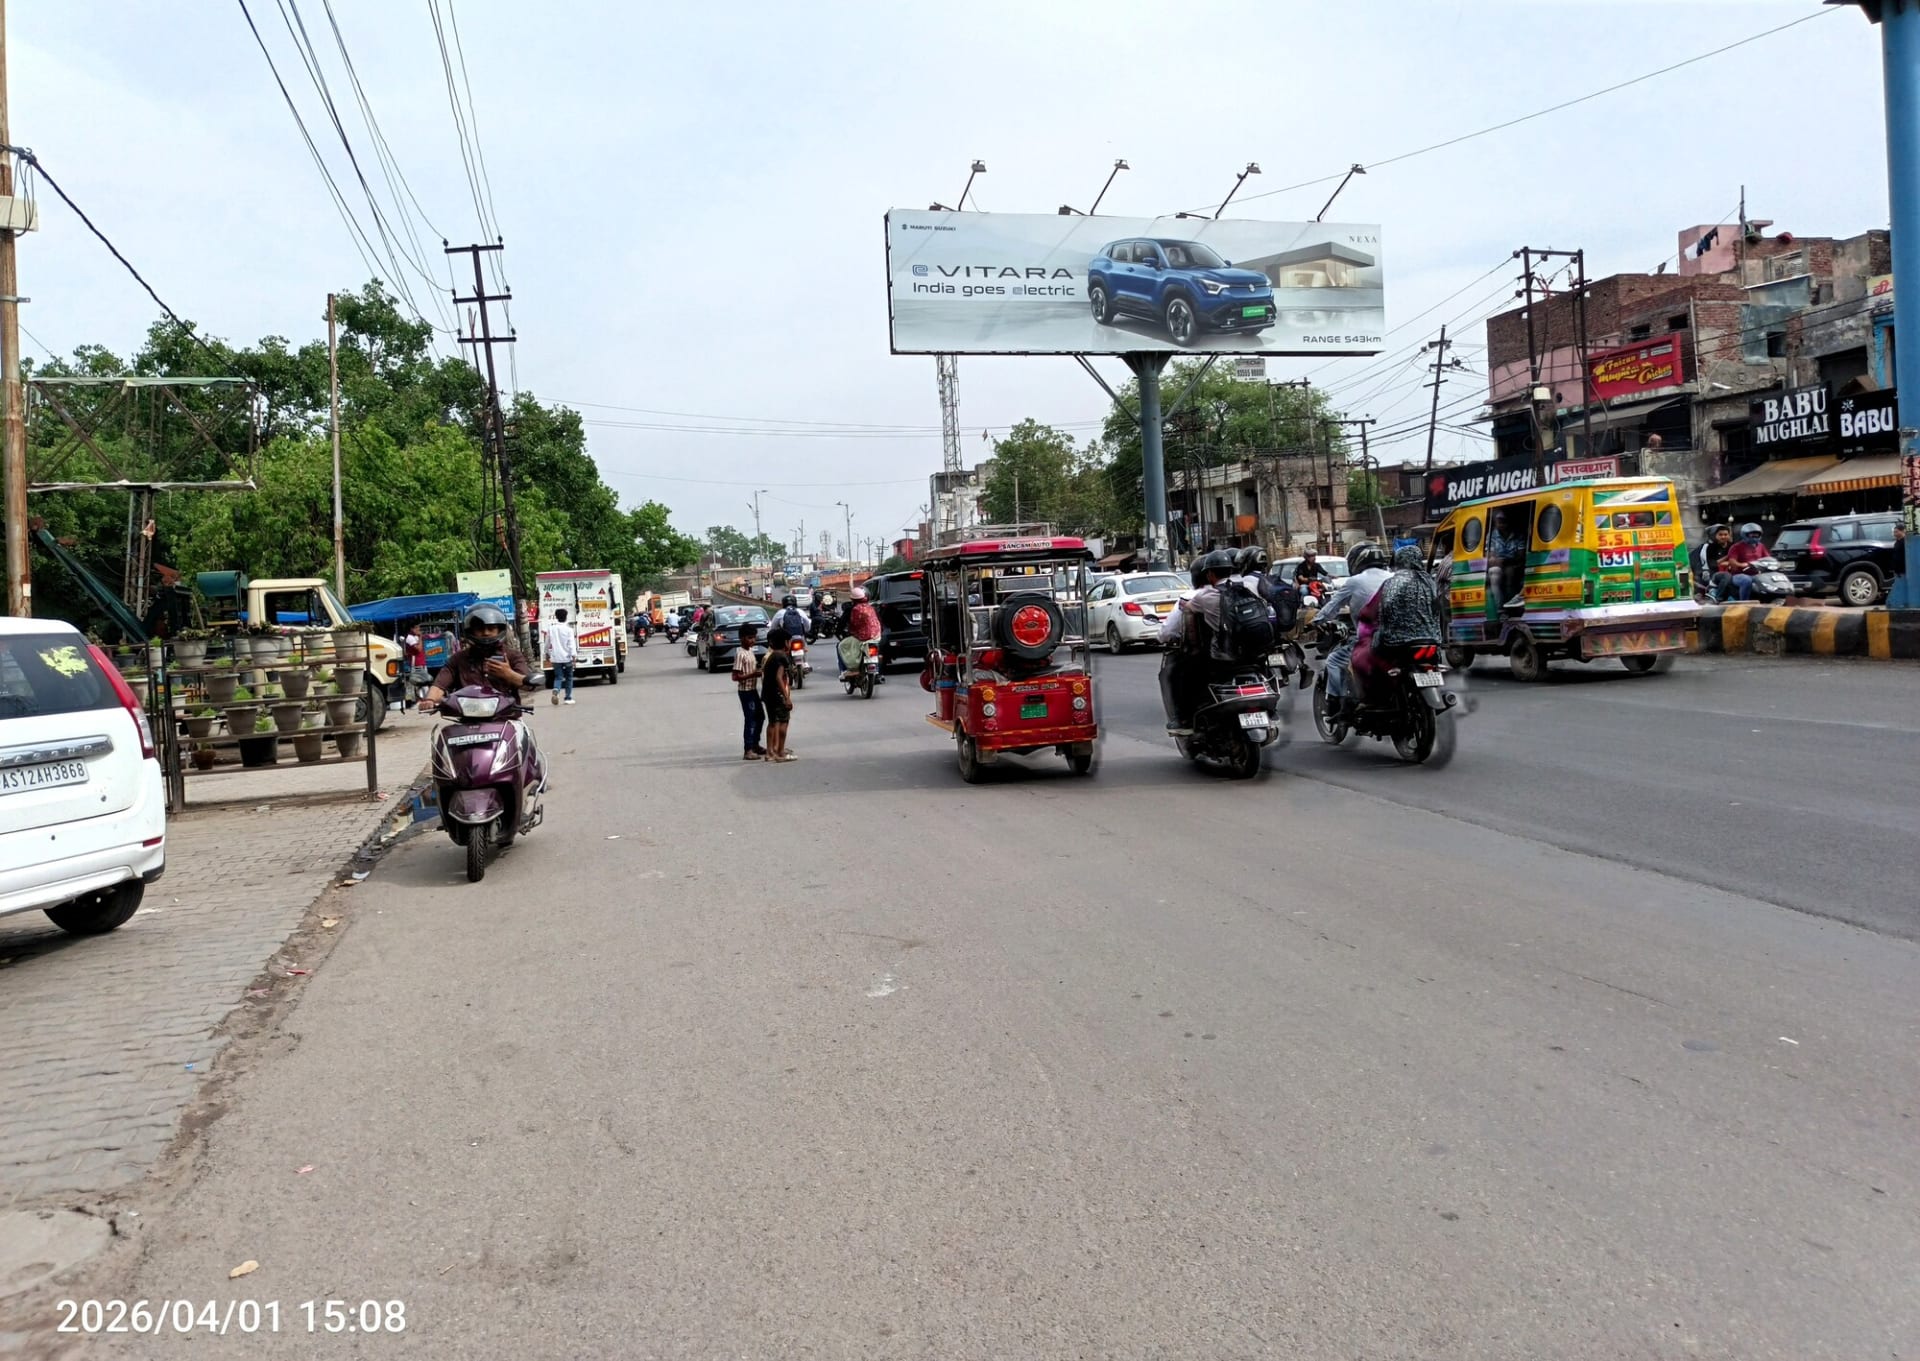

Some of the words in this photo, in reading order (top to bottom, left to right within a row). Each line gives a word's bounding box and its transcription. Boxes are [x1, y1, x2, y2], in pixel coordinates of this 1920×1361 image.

[1348, 235, 1377, 244] NEXA
[937, 264, 1074, 280] VITARA
[913, 282, 956, 295] India
[962, 285, 1006, 297] goes
[1012, 284, 1075, 297] electric
[1302, 335, 1342, 343] RANGE
[1344, 335, 1382, 343] 543km
[1763, 388, 1828, 423] BABU
[1756, 413, 1831, 445] MUGHLAI
[1840, 406, 1893, 438] BABU
[1448, 476, 1485, 502] RAUF
[1598, 533, 1629, 546] S.S.
[2, 762, 85, 789] AS12AH3868
